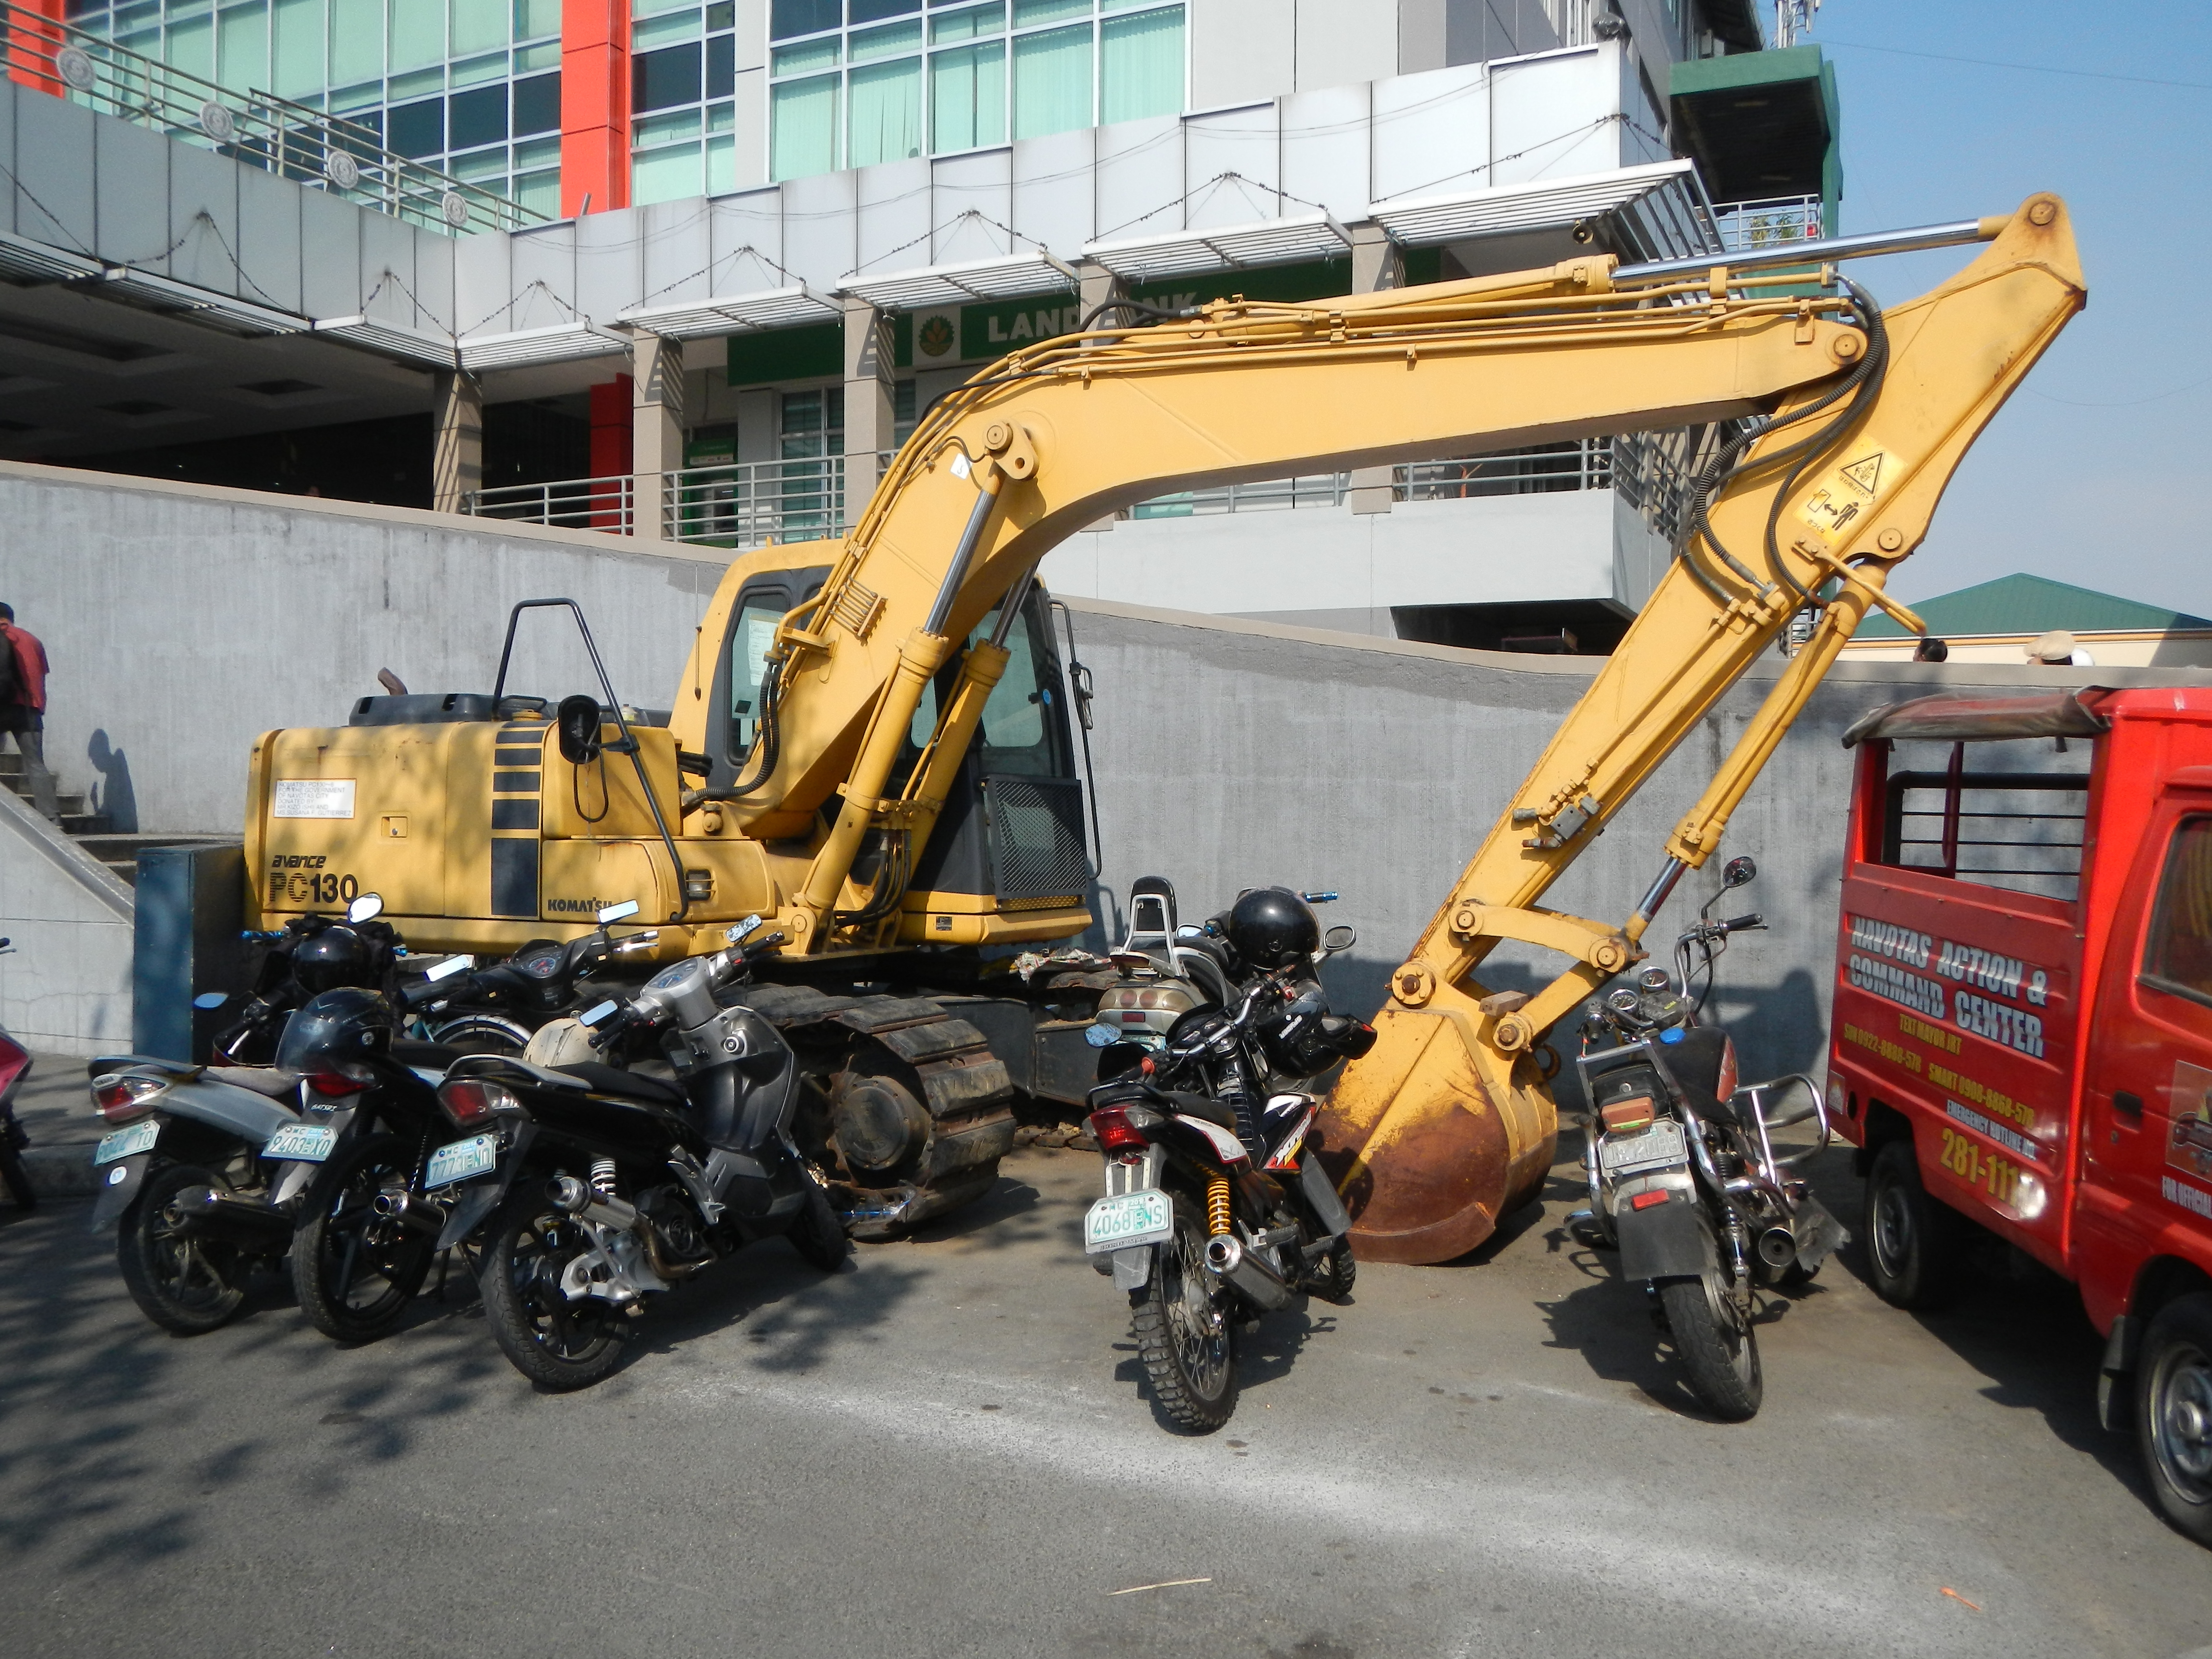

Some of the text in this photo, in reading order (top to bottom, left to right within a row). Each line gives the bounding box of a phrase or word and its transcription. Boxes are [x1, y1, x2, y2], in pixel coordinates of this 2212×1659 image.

[271, 855, 326, 868] avance
[270, 873, 358, 904] PC130
[1851, 916, 2047, 1006] NAVOTAS ACTION &
[1850, 954, 2044, 1058] COMMAND CENTER
[1899, 1013, 1917, 1035] TEXT
[1929, 1063, 1958, 1091] SMART
[1947, 1099, 1988, 1134] EMERGENCY
[1989, 1120, 2022, 1153] HOTLINE
[2163, 1175, 2176, 1203] FOR
[1093, 1211, 1130, 1236] 4068
[1143, 1205, 1163, 1227] NS
